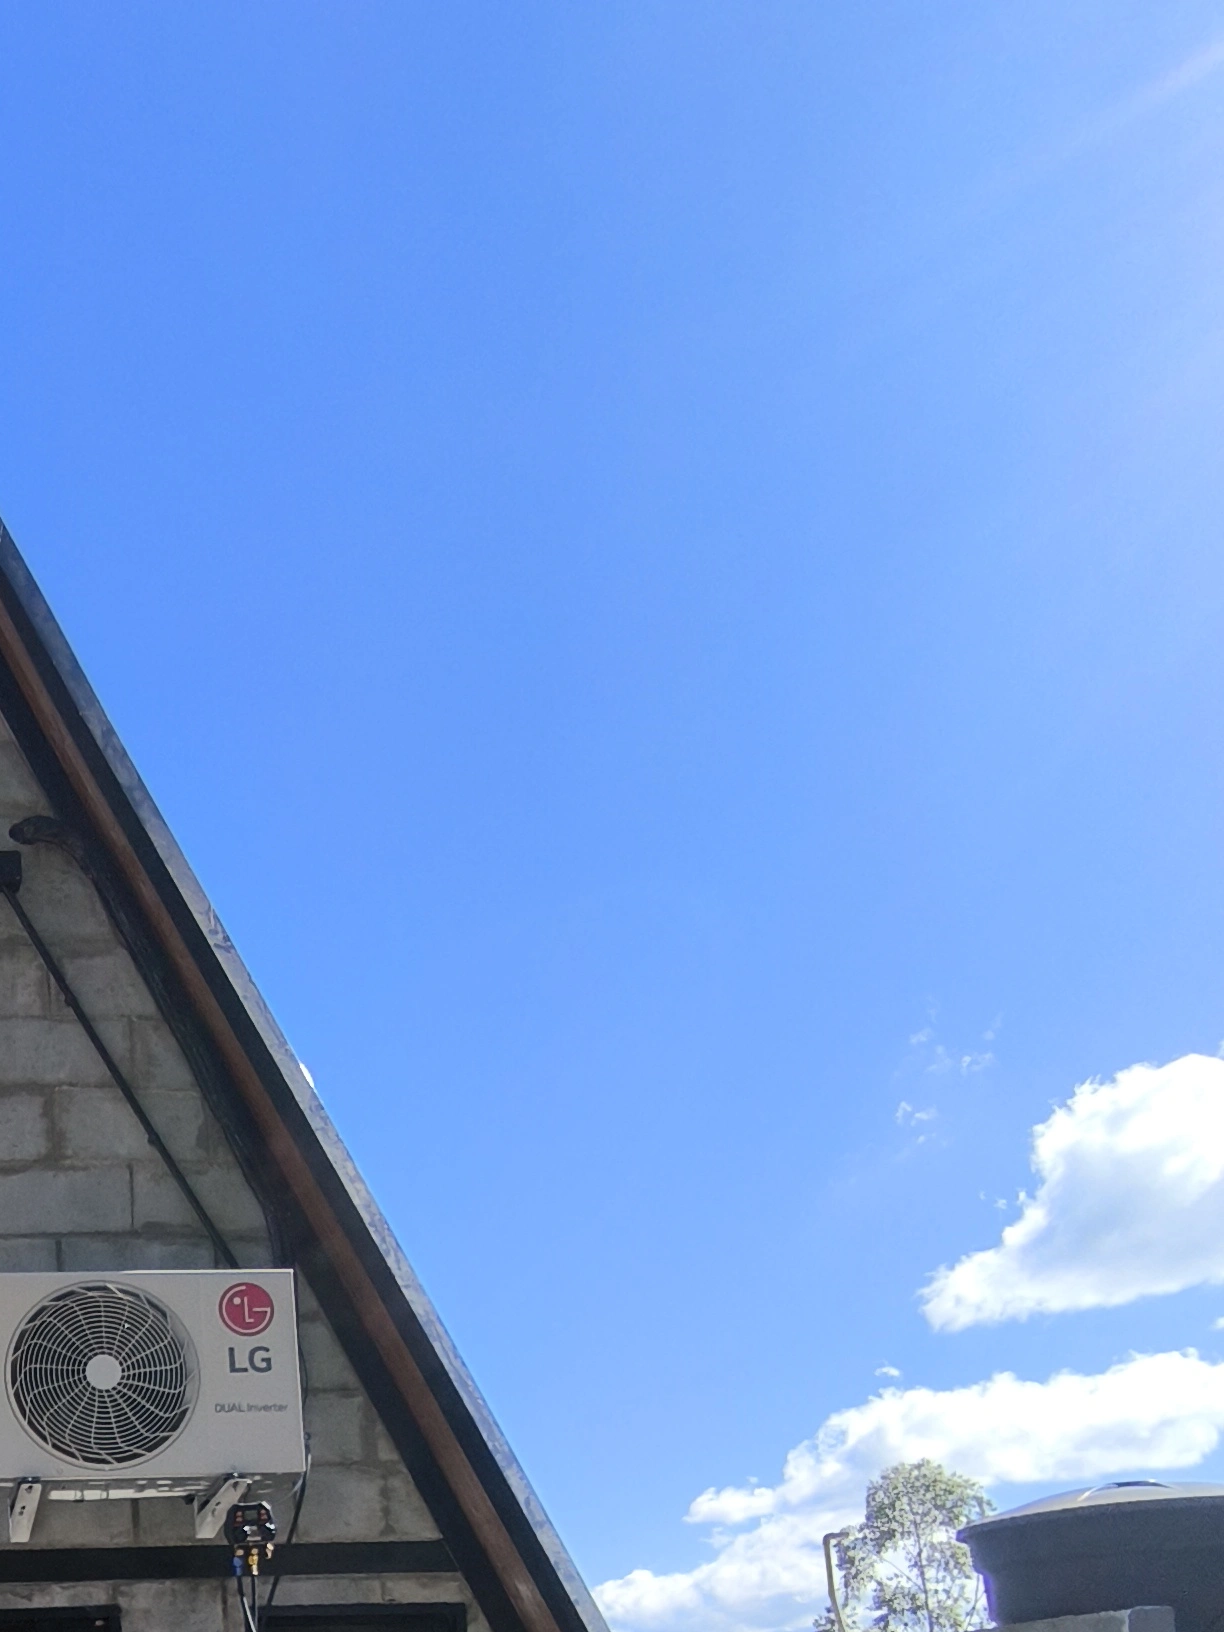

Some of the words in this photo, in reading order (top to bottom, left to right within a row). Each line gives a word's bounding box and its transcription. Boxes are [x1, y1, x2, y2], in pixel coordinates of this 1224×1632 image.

[228, 1346, 272, 1373] LG
[214, 1402, 245, 1413] DUAL
[246, 1402, 289, 1413] Inverter
